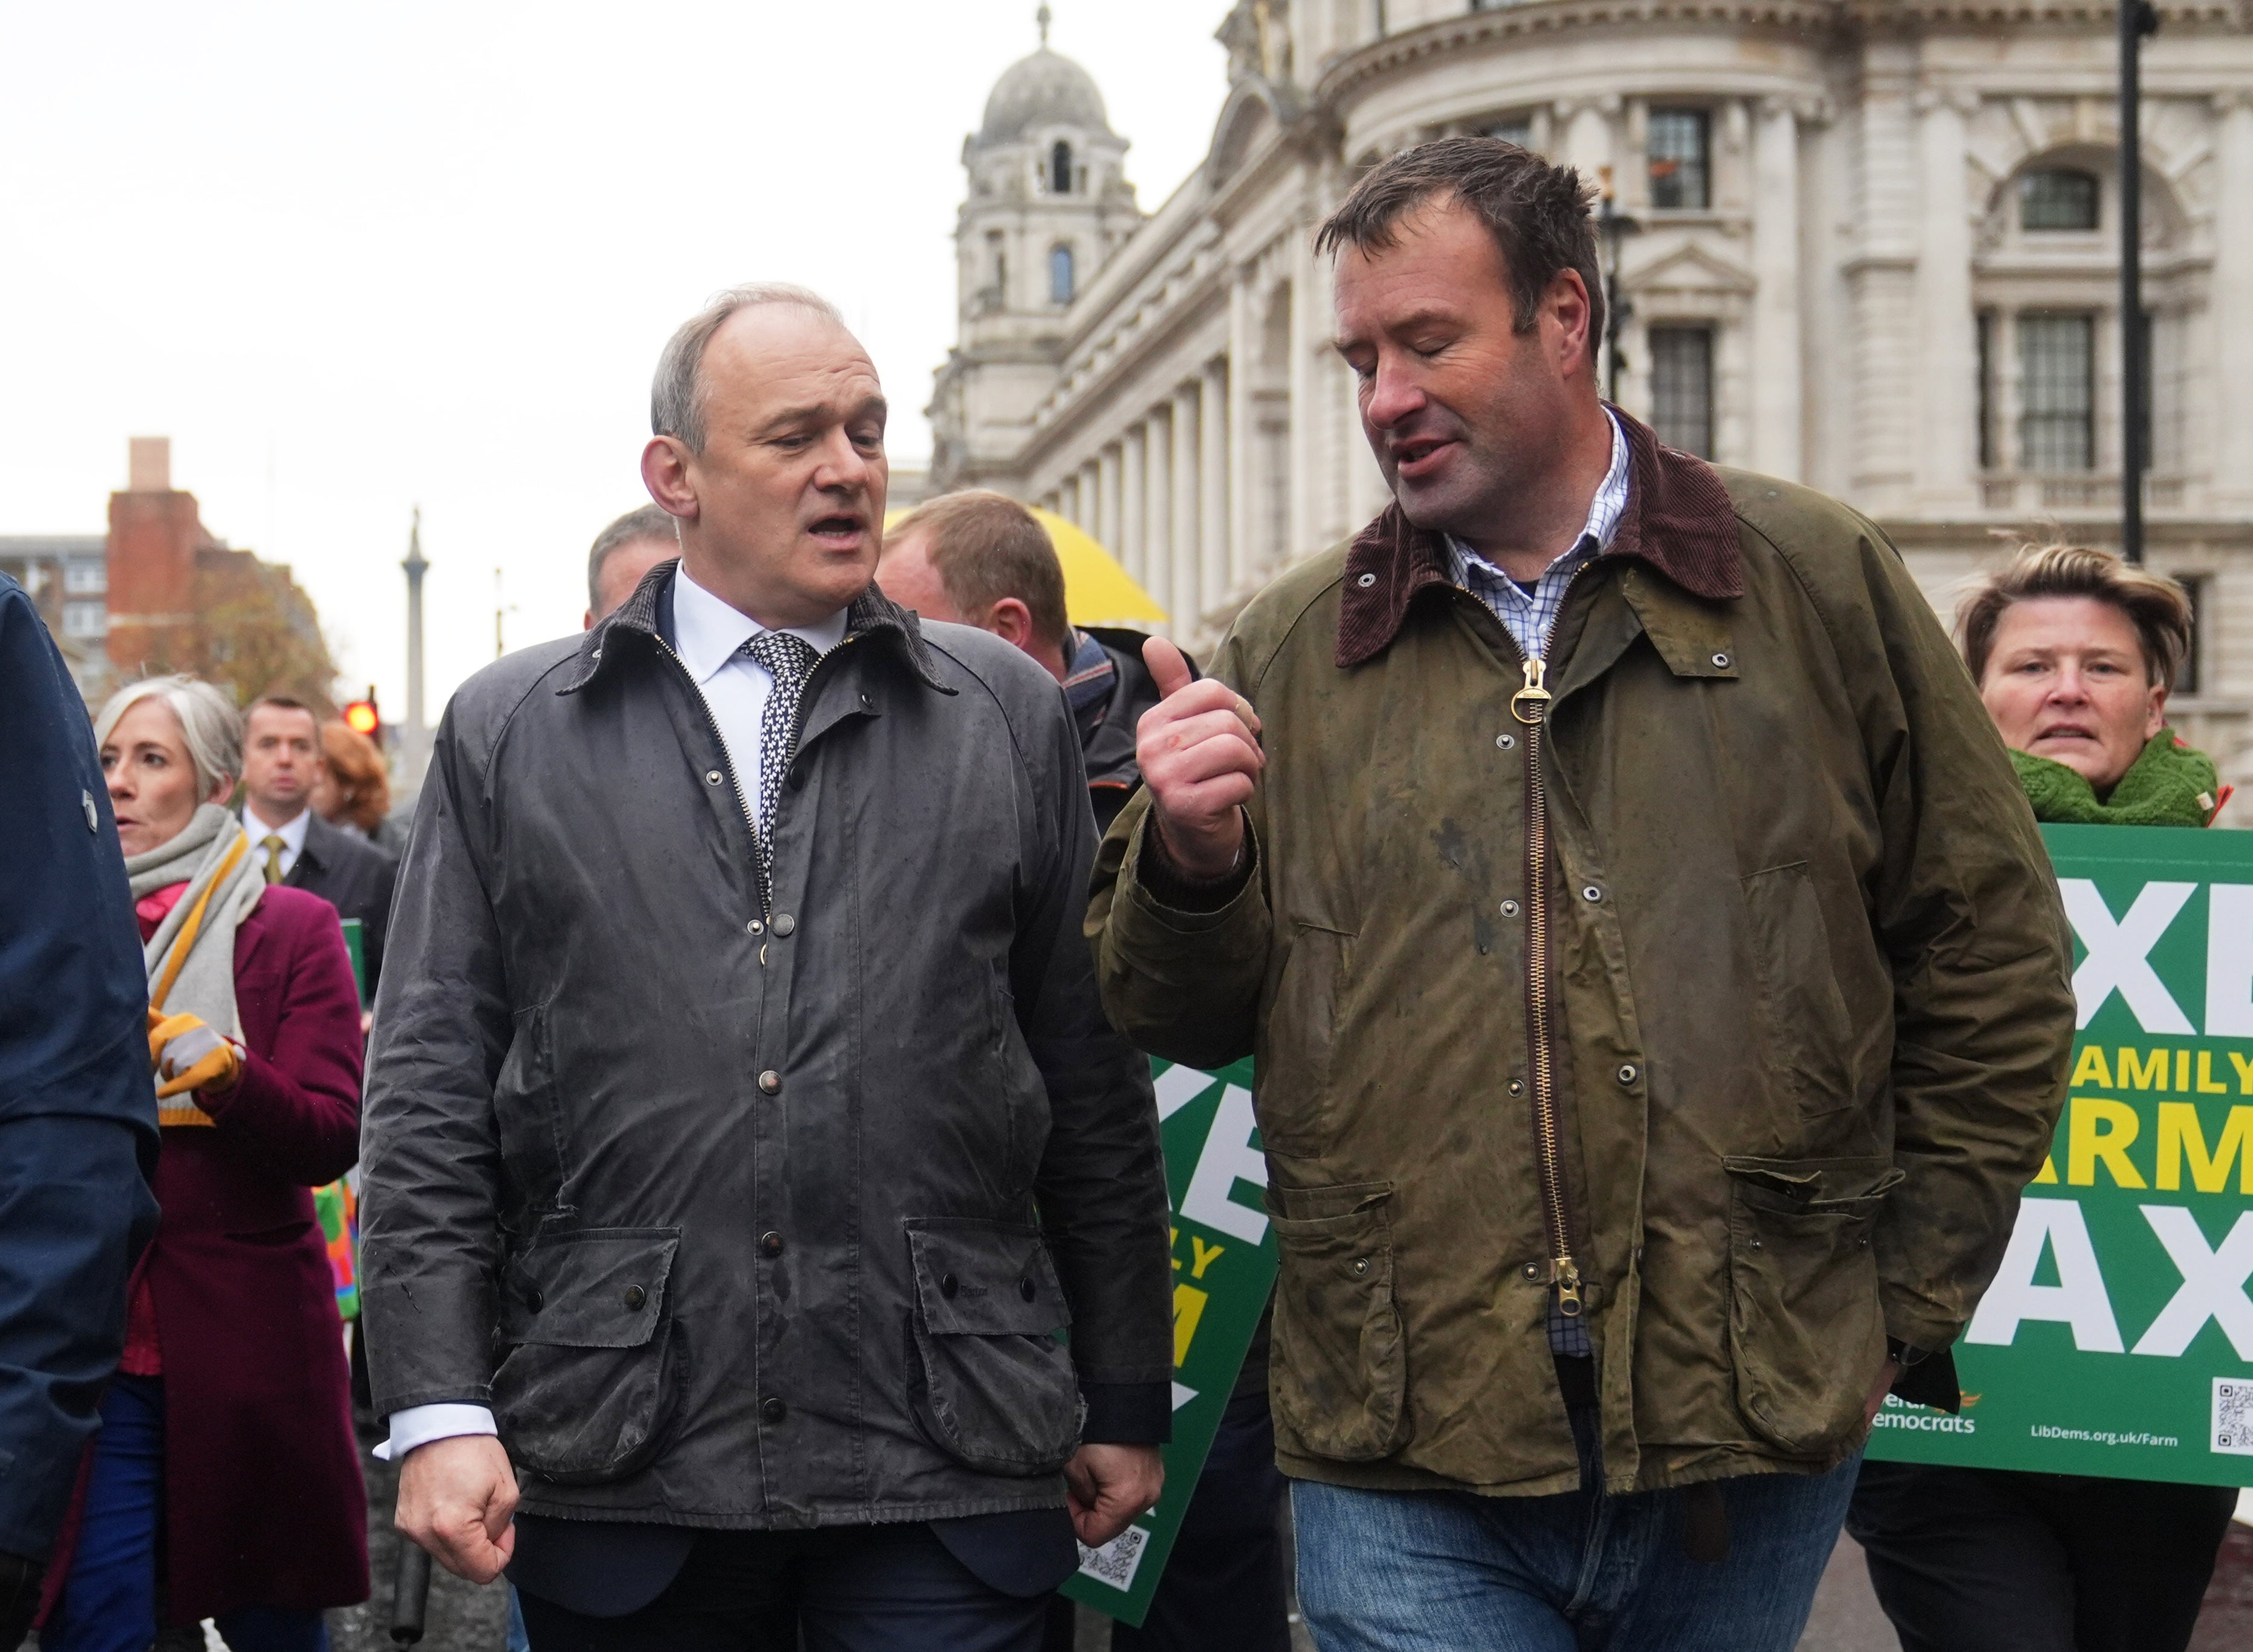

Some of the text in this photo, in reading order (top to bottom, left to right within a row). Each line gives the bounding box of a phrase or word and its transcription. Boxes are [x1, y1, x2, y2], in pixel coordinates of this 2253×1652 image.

[2030, 1097, 2253, 1194] RM
[1964, 1197, 2253, 1362] AX
[1872, 1411, 1975, 1434] emocrats
[2030, 1424, 2178, 1446] LibDems.org.uk/Farm
